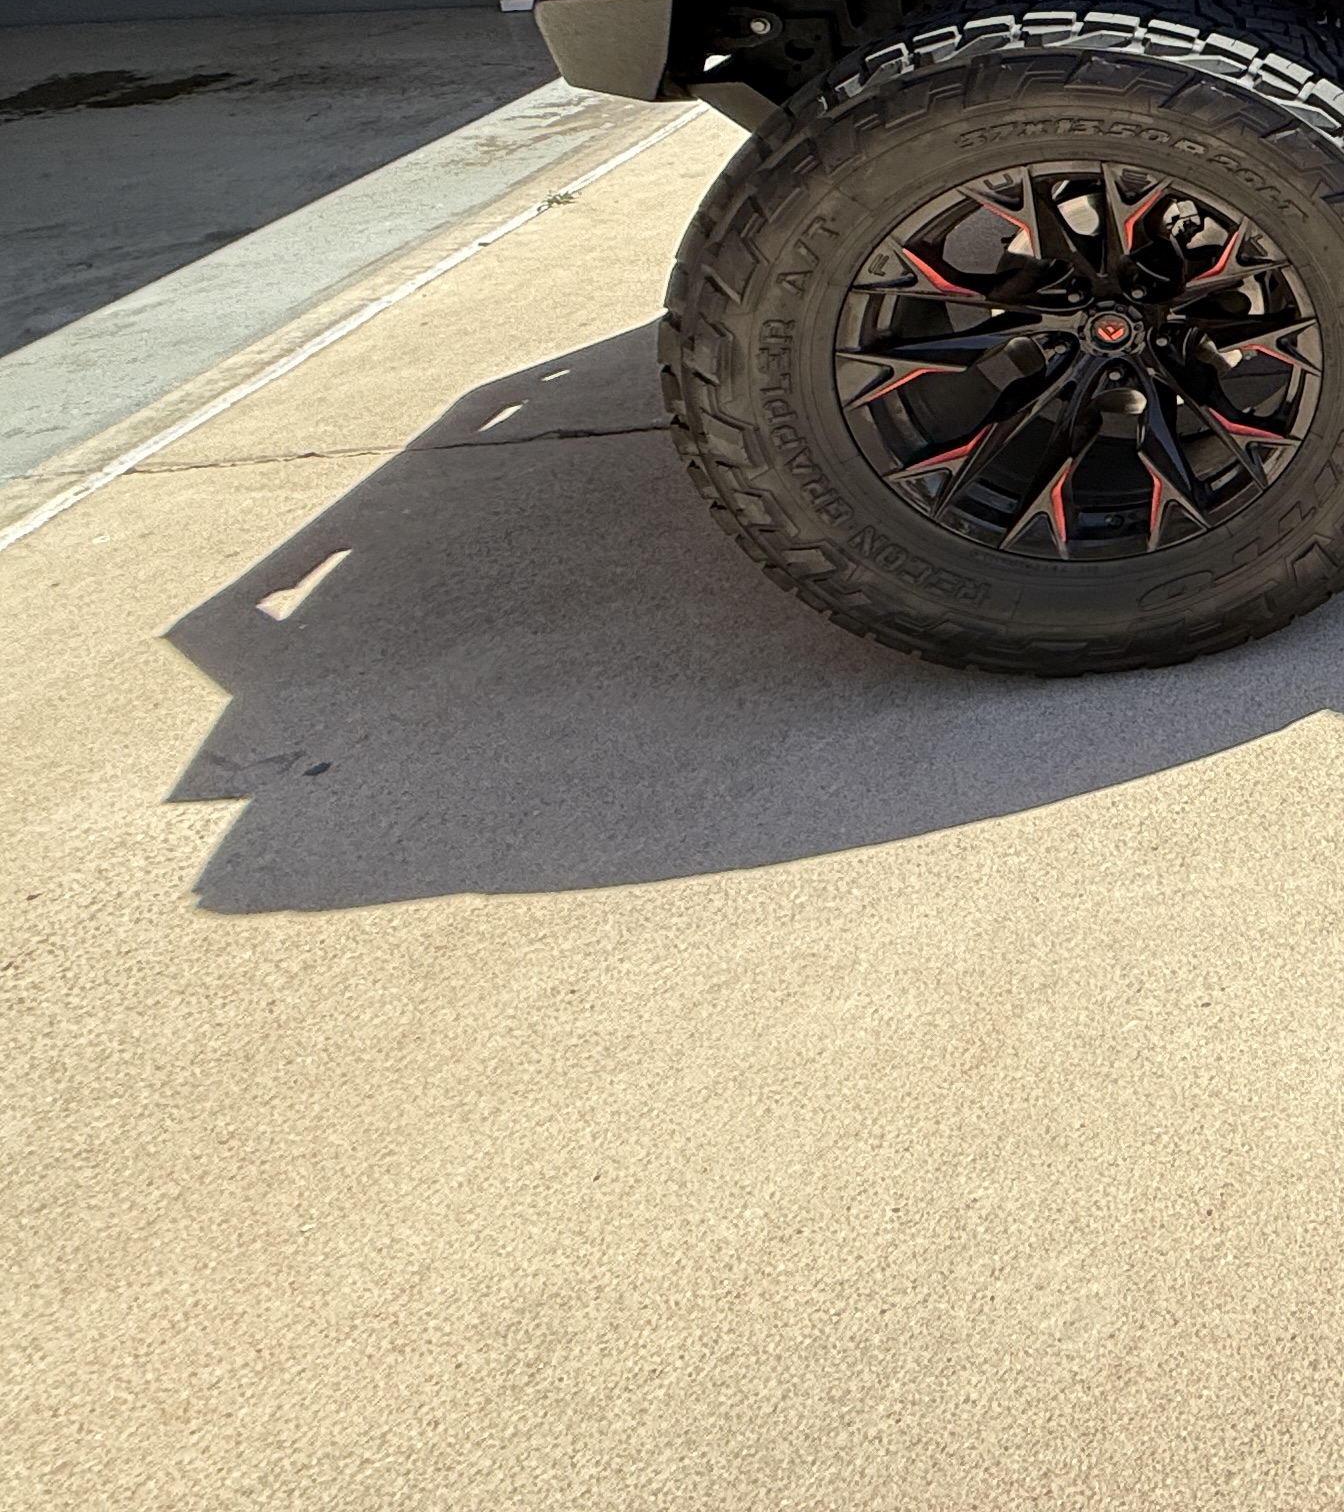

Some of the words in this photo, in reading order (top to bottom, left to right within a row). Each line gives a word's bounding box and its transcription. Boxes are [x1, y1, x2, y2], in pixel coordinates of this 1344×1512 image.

[776, 215, 841, 294] A/T
[758, 318, 856, 529] GRAPPLER
[848, 524, 994, 607] RECON
